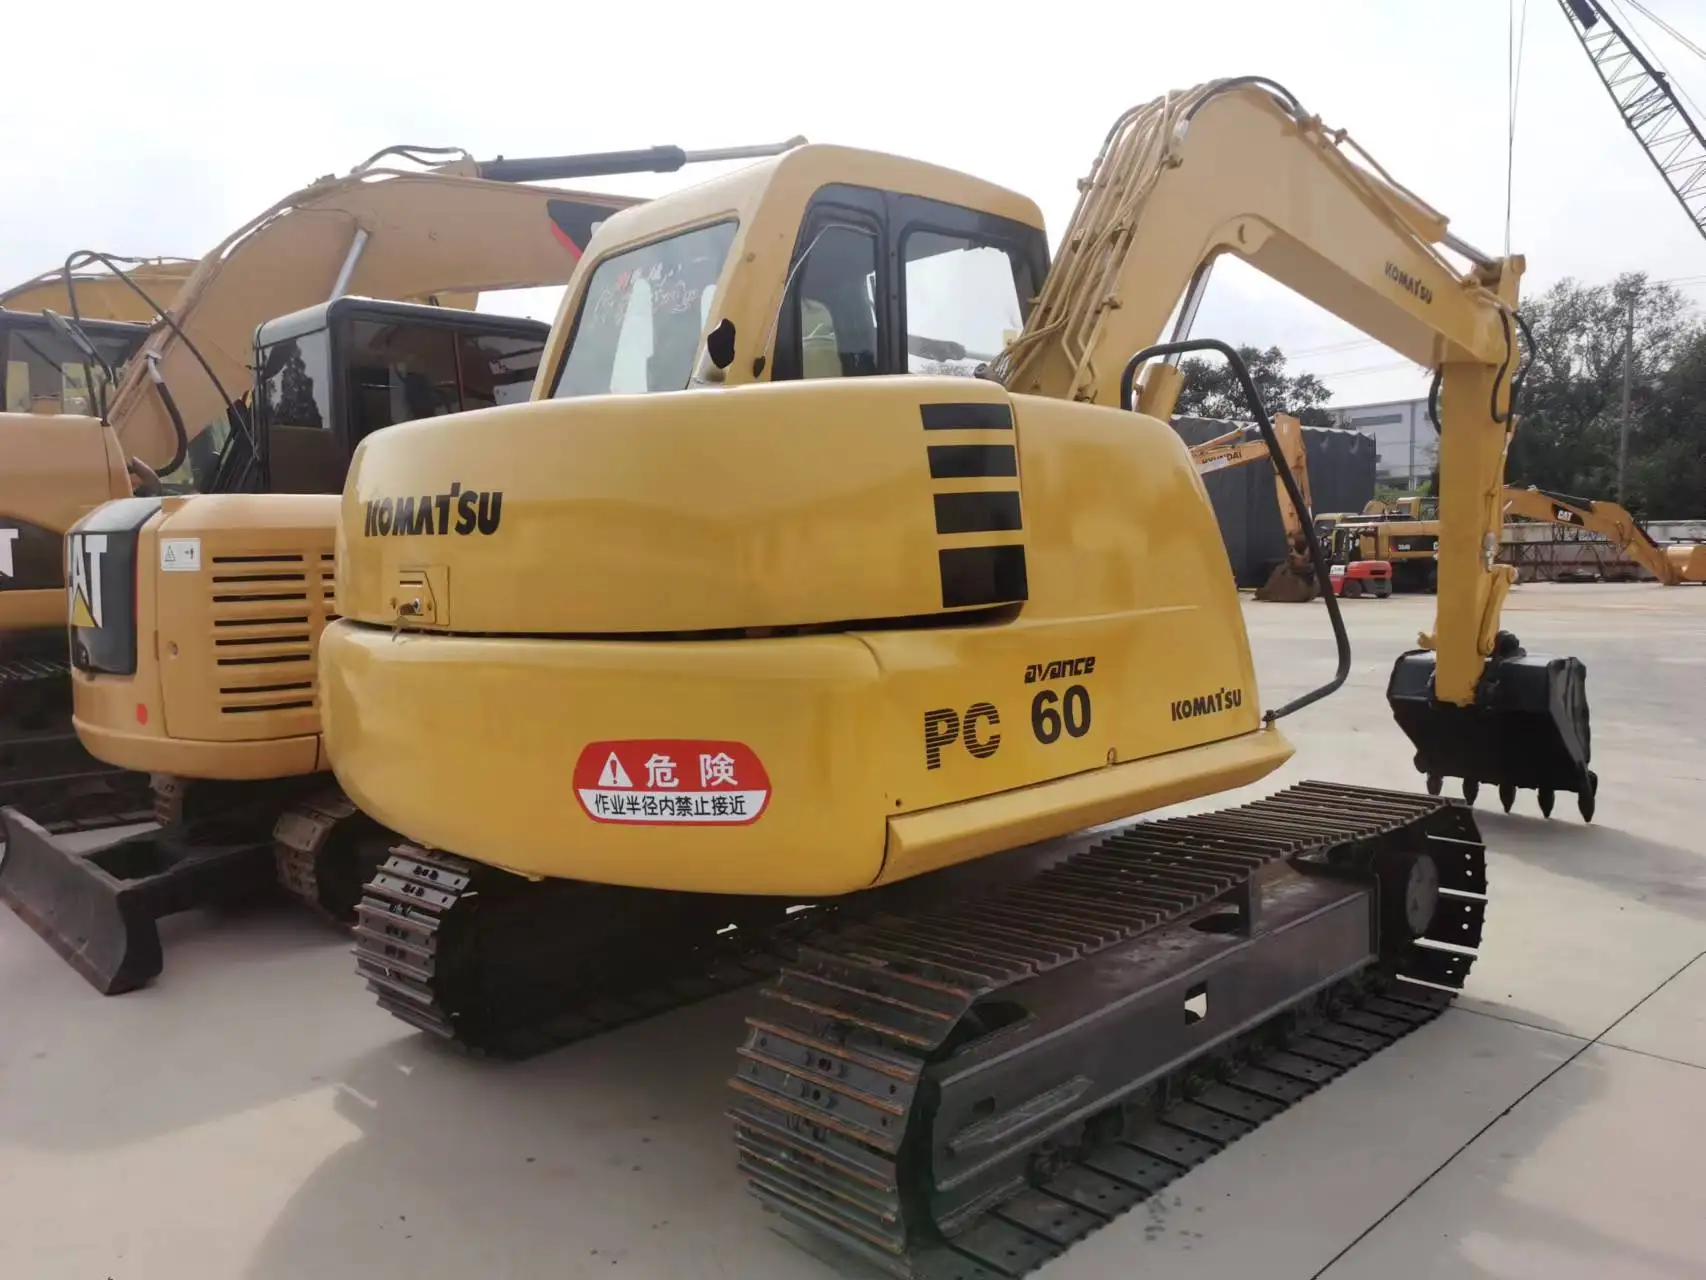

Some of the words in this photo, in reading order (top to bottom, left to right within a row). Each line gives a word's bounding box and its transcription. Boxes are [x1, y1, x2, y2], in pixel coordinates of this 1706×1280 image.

[1385, 261, 1432, 305] KOMATSU
[365, 482, 502, 537] KOMATSU
[68, 534, 108, 628] AT
[924, 702, 1000, 770] PC
[1031, 684, 1091, 745] 60
[1171, 687, 1242, 721] KOMATSU
[594, 793, 747, 817] 作业半径内禁止接近
